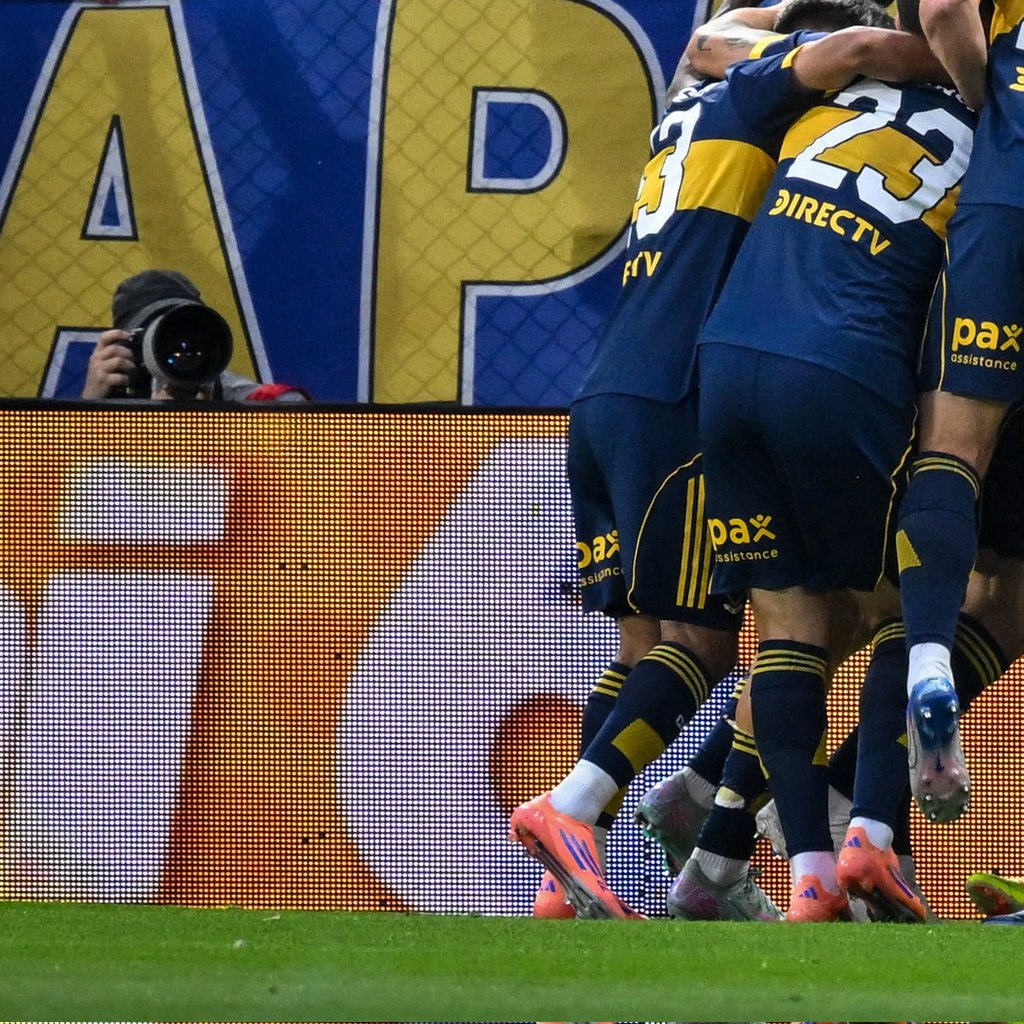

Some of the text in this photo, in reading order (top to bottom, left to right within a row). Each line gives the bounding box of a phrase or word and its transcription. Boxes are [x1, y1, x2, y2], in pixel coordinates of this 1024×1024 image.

[786, 78, 975, 225] 23
[768, 189, 892, 257] DIRECTV
[951, 317, 1024, 353] pax
[950, 353, 1017, 371] assistance
[707, 514, 777, 551] pax
